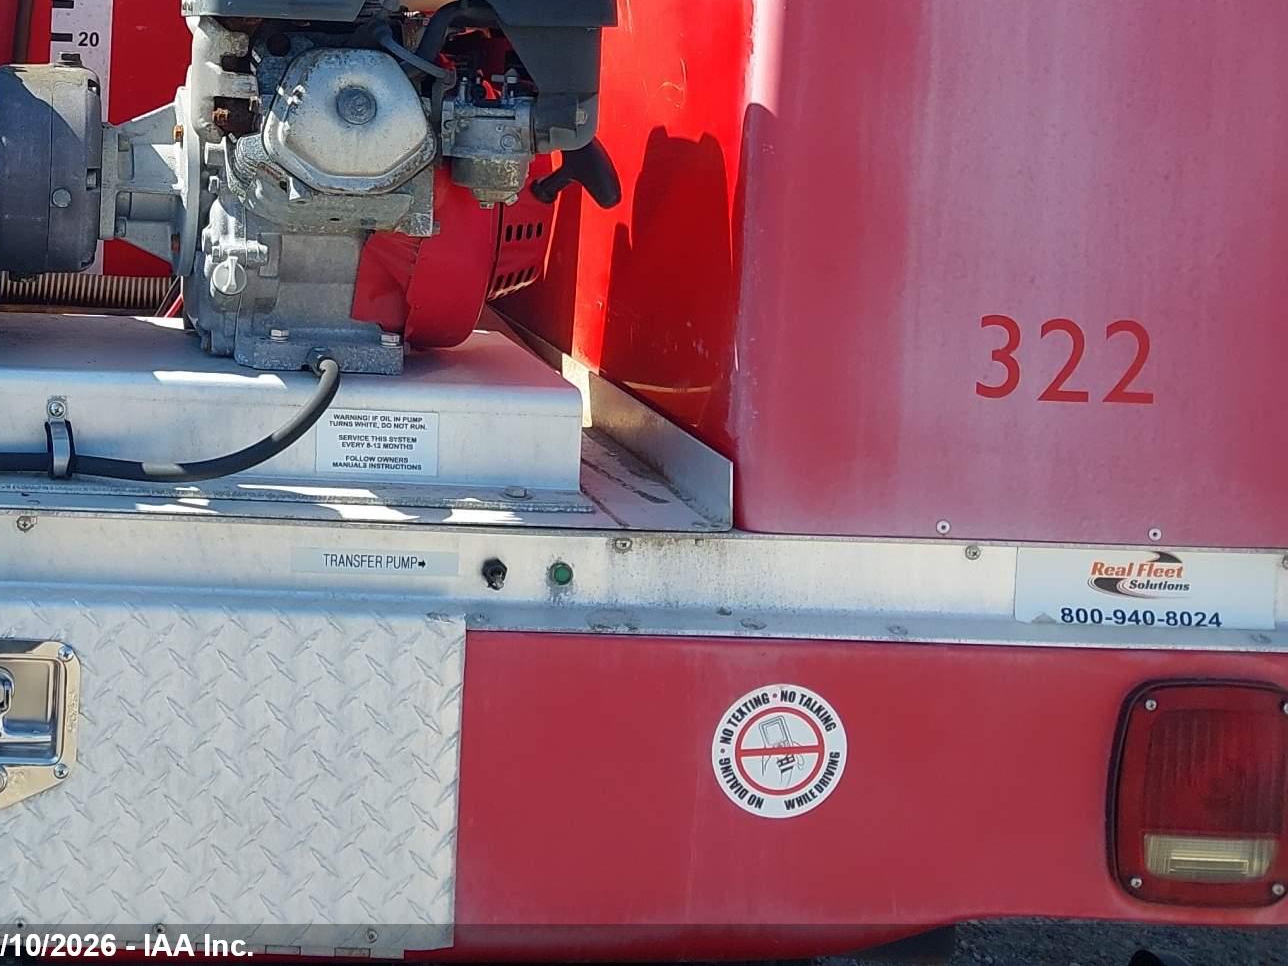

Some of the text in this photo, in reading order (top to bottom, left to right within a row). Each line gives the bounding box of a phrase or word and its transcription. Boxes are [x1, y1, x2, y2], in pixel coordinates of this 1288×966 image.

[77, 31, 100, 47] 20
[975, 314, 1154, 405] 322
[371, 435, 388, 443] THIS
[388, 436, 417, 444] SYSTEM
[345, 455, 409, 464] FOLLOW OWNERS
[368, 462, 423, 471] INSTRUCTIONS
[323, 553, 418, 570] TRANSFER PUMP
[1090, 560, 1184, 579] Real Fleet
[1128, 578, 1190, 591] Solutions
[1060, 607, 1223, 628] 800-940-8024
[719, 692, 770, 745] NO TEXTING
[780, 689, 837, 733] NO TALKING
[718, 757, 765, 810] NO DIALING
[783, 751, 841, 811] WHILE DRIVING
